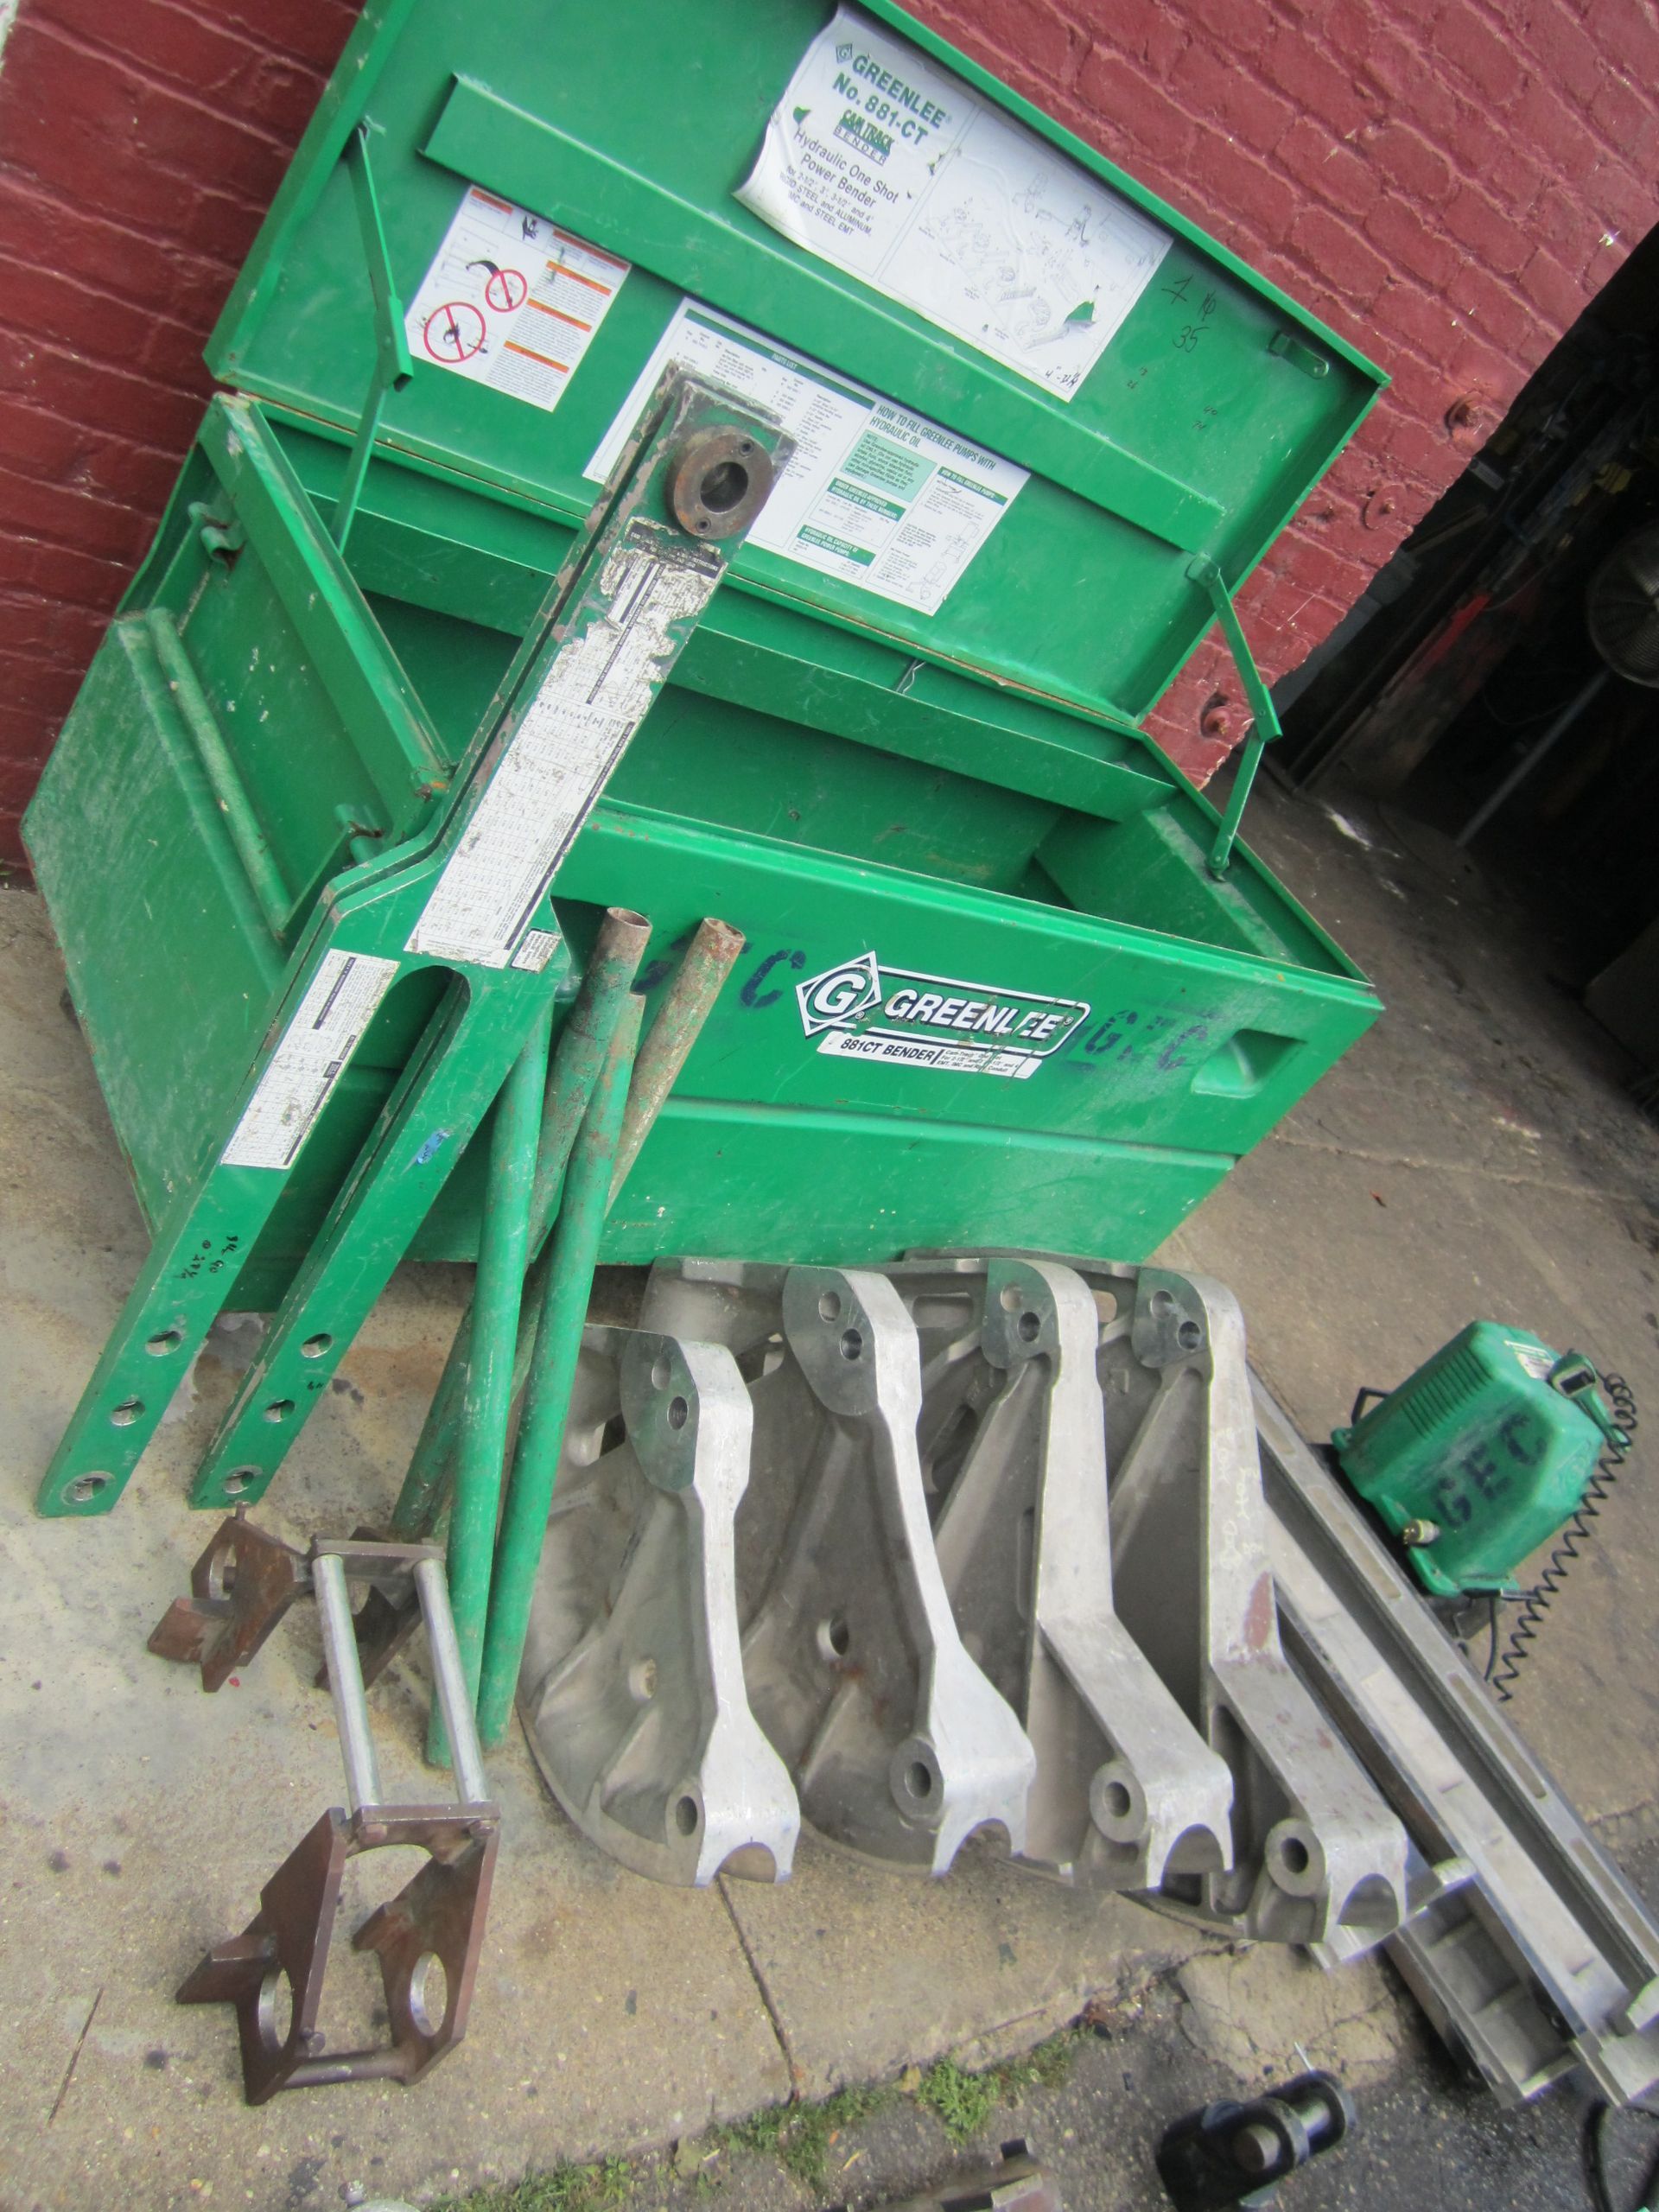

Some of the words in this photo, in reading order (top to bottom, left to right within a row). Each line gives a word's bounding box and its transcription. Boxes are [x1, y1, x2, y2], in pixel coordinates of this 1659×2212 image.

[832, 72, 861, 105] No.
[865, 95, 928, 145] 881-CT
[852, 55, 946, 129] GREENLEE
[793, 127, 847, 170] Hydraulic
[849, 164, 872, 186] One
[873, 180, 899, 204] Shot
[833, 124, 887, 164] BENDER
[798, 185, 819, 204] STEEL
[801, 153, 836, 182] Power
[838, 176, 876, 208] Bender
[815, 207, 836, 227] STEEL
[1173, 326, 1210, 353] 35
[870, 416, 909, 442] HYDRAULIC
[909, 435, 921, 448] OIL
[876, 404, 897, 422] HOW
[897, 414, 908, 427] TO
[906, 418, 921, 434] FILL
[920, 427, 954, 448] GREENLEE
[952, 442, 980, 461] PUMPS
[977, 454, 996, 470] WITH
[813, 973, 867, 1014] G
[883, 988, 1065, 1041] GREENLEE
[840, 1038, 883, 1054] 881CT
[882, 1044, 936, 1065] BENDER
[1433, 1411, 1548, 1528] GEC
